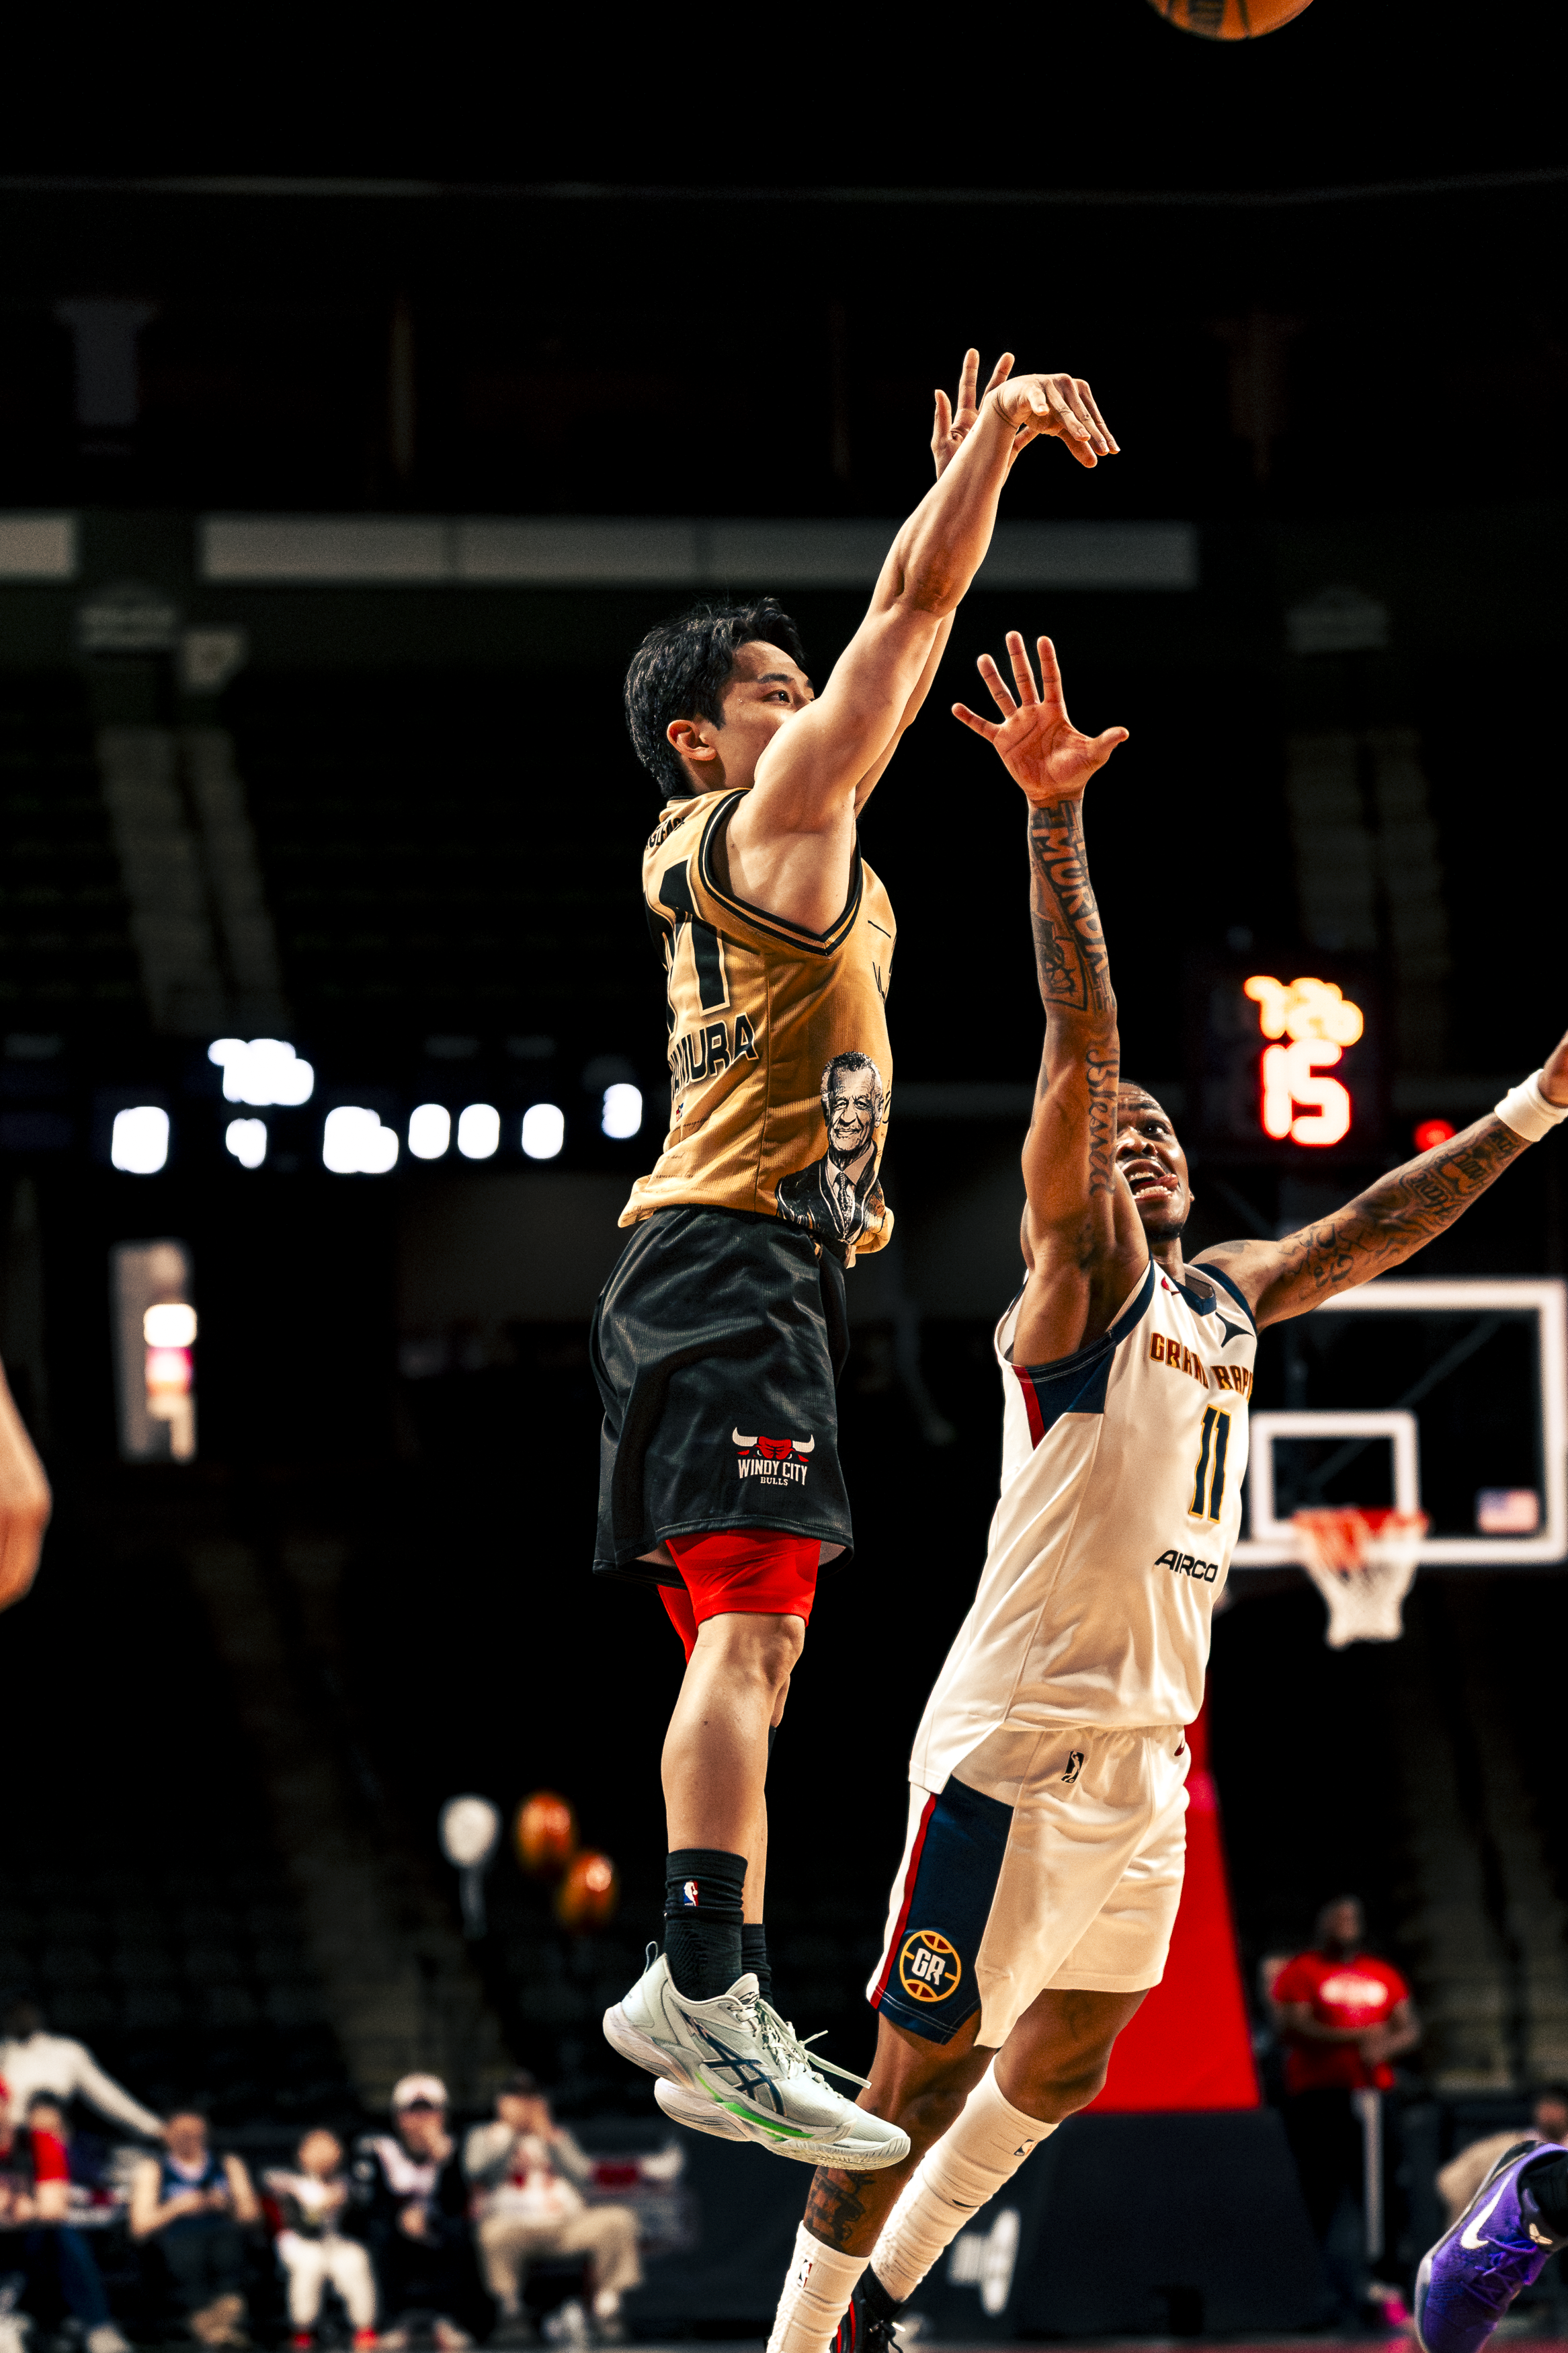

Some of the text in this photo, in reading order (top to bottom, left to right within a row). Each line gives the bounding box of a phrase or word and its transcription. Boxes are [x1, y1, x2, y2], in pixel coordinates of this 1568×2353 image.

[1261, 1041, 1350, 1146] 15
[1210, 1364, 1253, 1403] RAPI
[737, 1458, 808, 1486] WINDY CITY
[759, 1476, 789, 1486] BULLS
[1188, 1403, 1232, 1525] 11
[1154, 1550, 1219, 1583] AIRCO
[911, 1948, 946, 1985] GR
